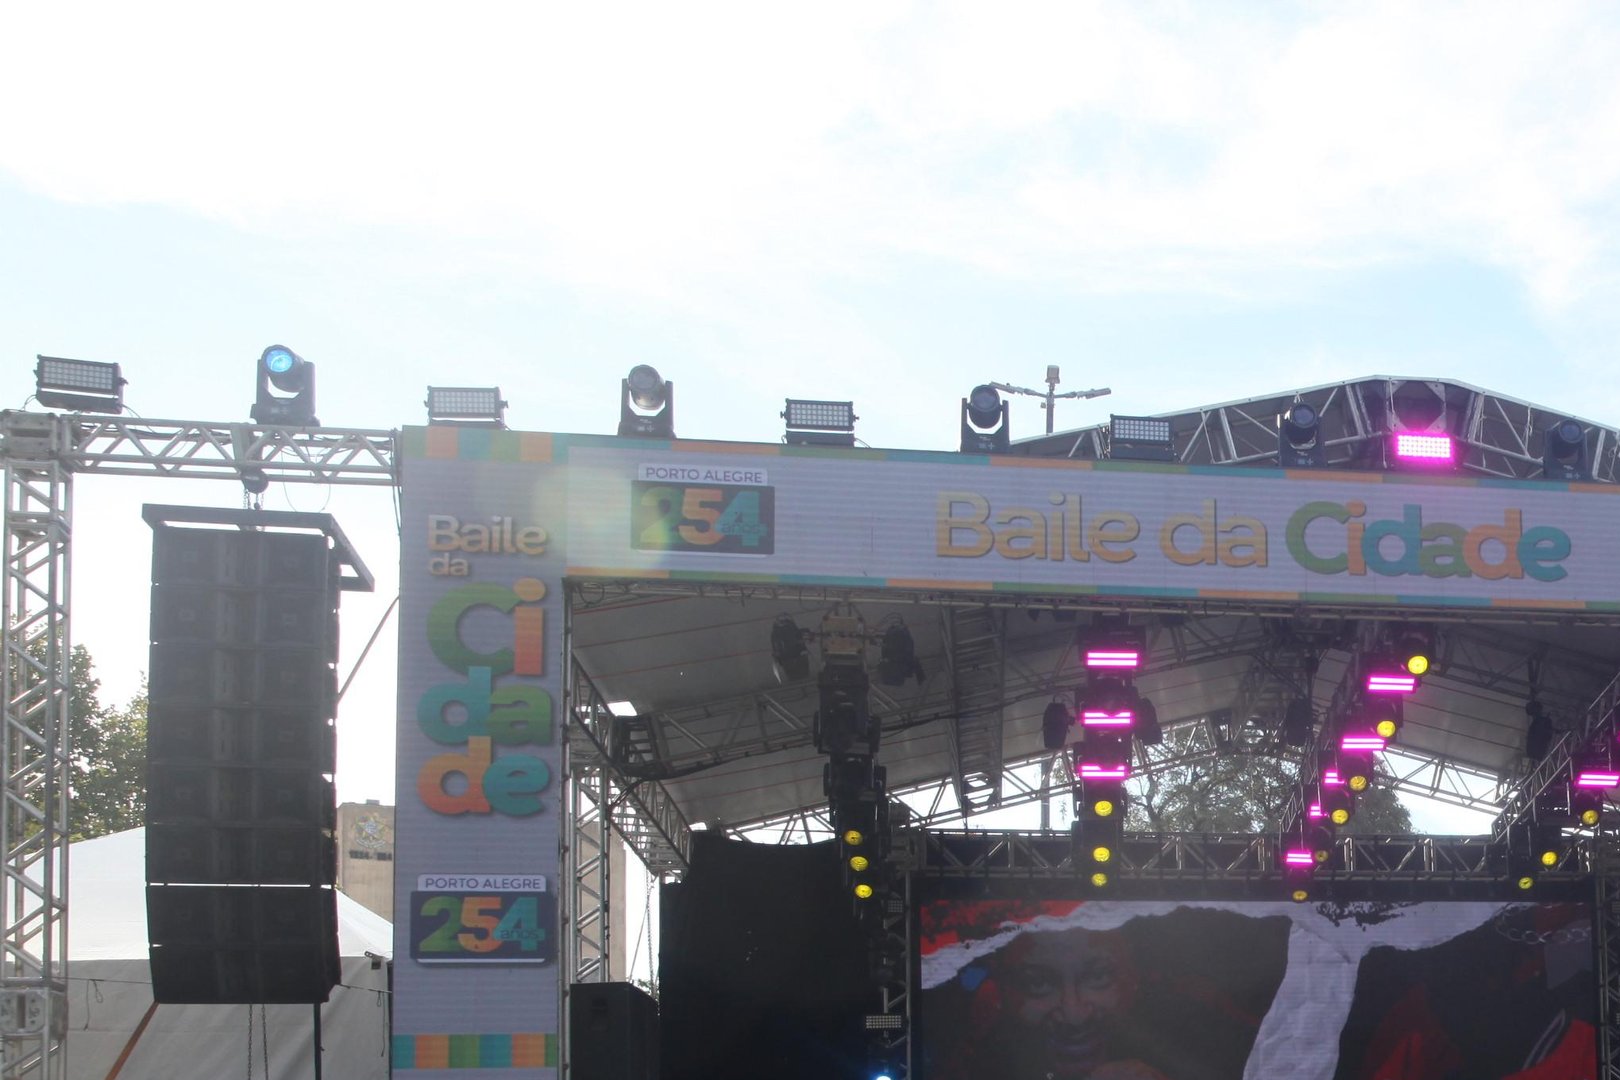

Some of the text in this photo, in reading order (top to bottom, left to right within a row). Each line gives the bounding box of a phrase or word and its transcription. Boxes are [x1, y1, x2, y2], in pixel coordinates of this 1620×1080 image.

[645, 467, 763, 484] PORTO ALEGRE
[428, 513, 548, 555] Baile
[639, 486, 769, 547] 254
[935, 490, 1573, 583] Baile da Cidade
[428, 551, 470, 576] da
[426, 577, 547, 677] Ci
[417, 666, 553, 747] da
[417, 736, 552, 817] de
[425, 877, 542, 889] PORTO ALEGRE
[419, 895, 546, 954] 254
